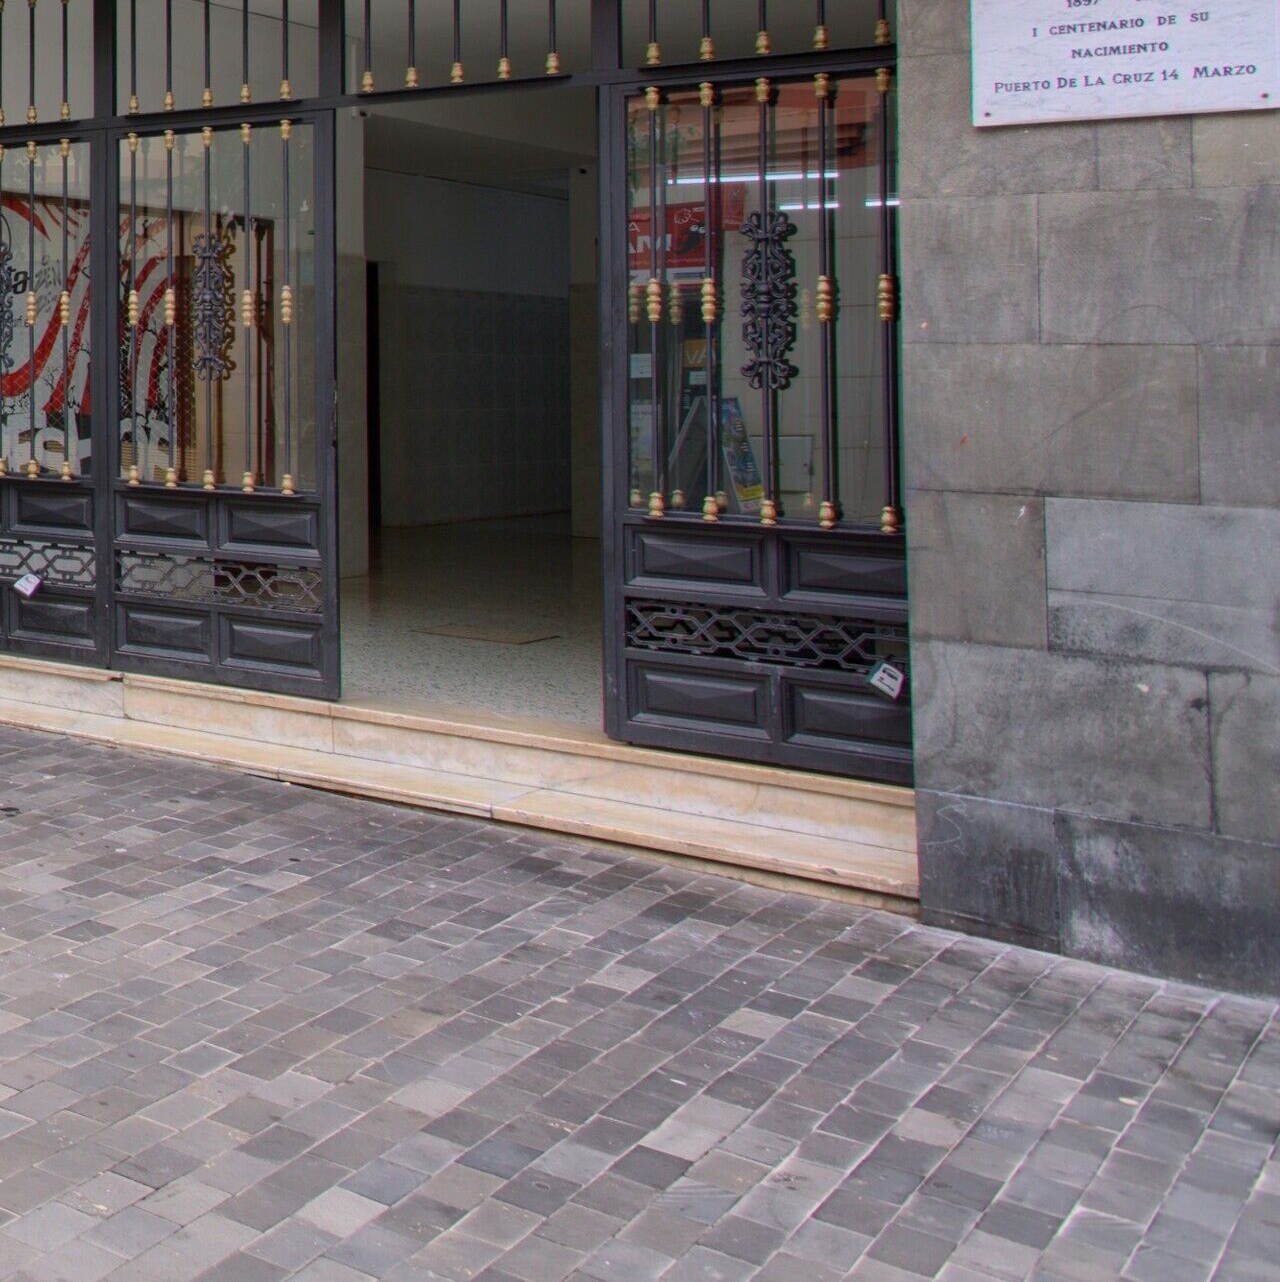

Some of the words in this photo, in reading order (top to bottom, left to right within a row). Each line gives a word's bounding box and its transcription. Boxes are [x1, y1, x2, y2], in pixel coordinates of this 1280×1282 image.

[1032, 27, 1038, 38] I
[1048, 17, 1145, 37] CENTENARIO
[1157, 14, 1178, 27] DE
[1189, 11, 1210, 24] SU
[1070, 41, 1170, 60] NACIMIENTO
[994, 79, 1051, 94] PUERTO
[1112, 71, 1155, 86] CRUZ
[1161, 68, 1180, 82] 14
[1192, 64, 1258, 80] MARZO
